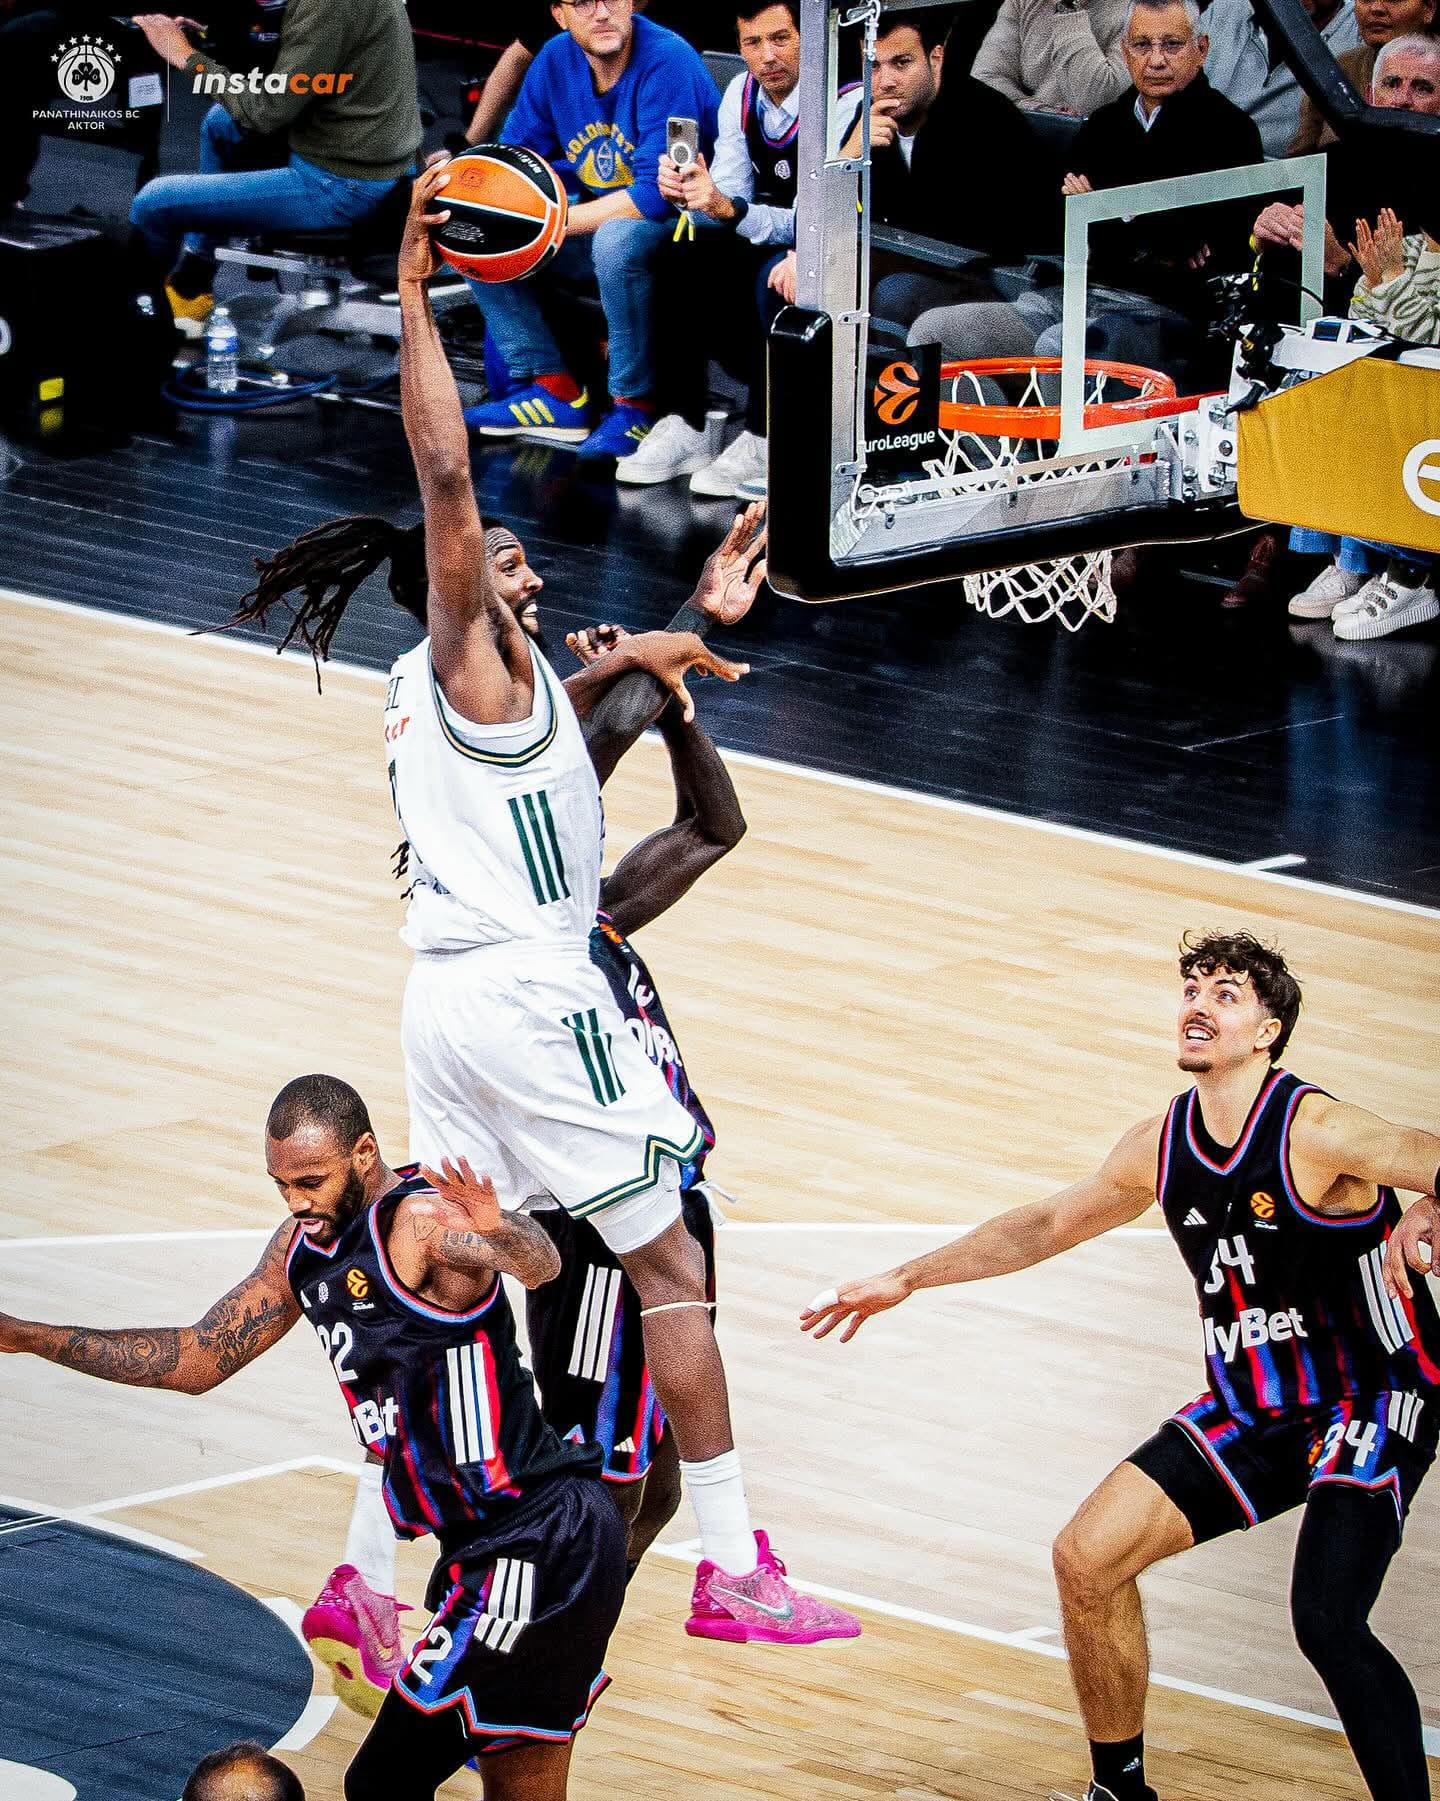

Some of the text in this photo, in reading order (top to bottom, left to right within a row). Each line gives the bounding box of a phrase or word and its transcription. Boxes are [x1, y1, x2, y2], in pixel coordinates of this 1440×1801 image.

[864, 430, 936, 453] uroLeague
[1203, 1307, 1309, 1363] lyBet
[1315, 1419, 1379, 1467] 34
